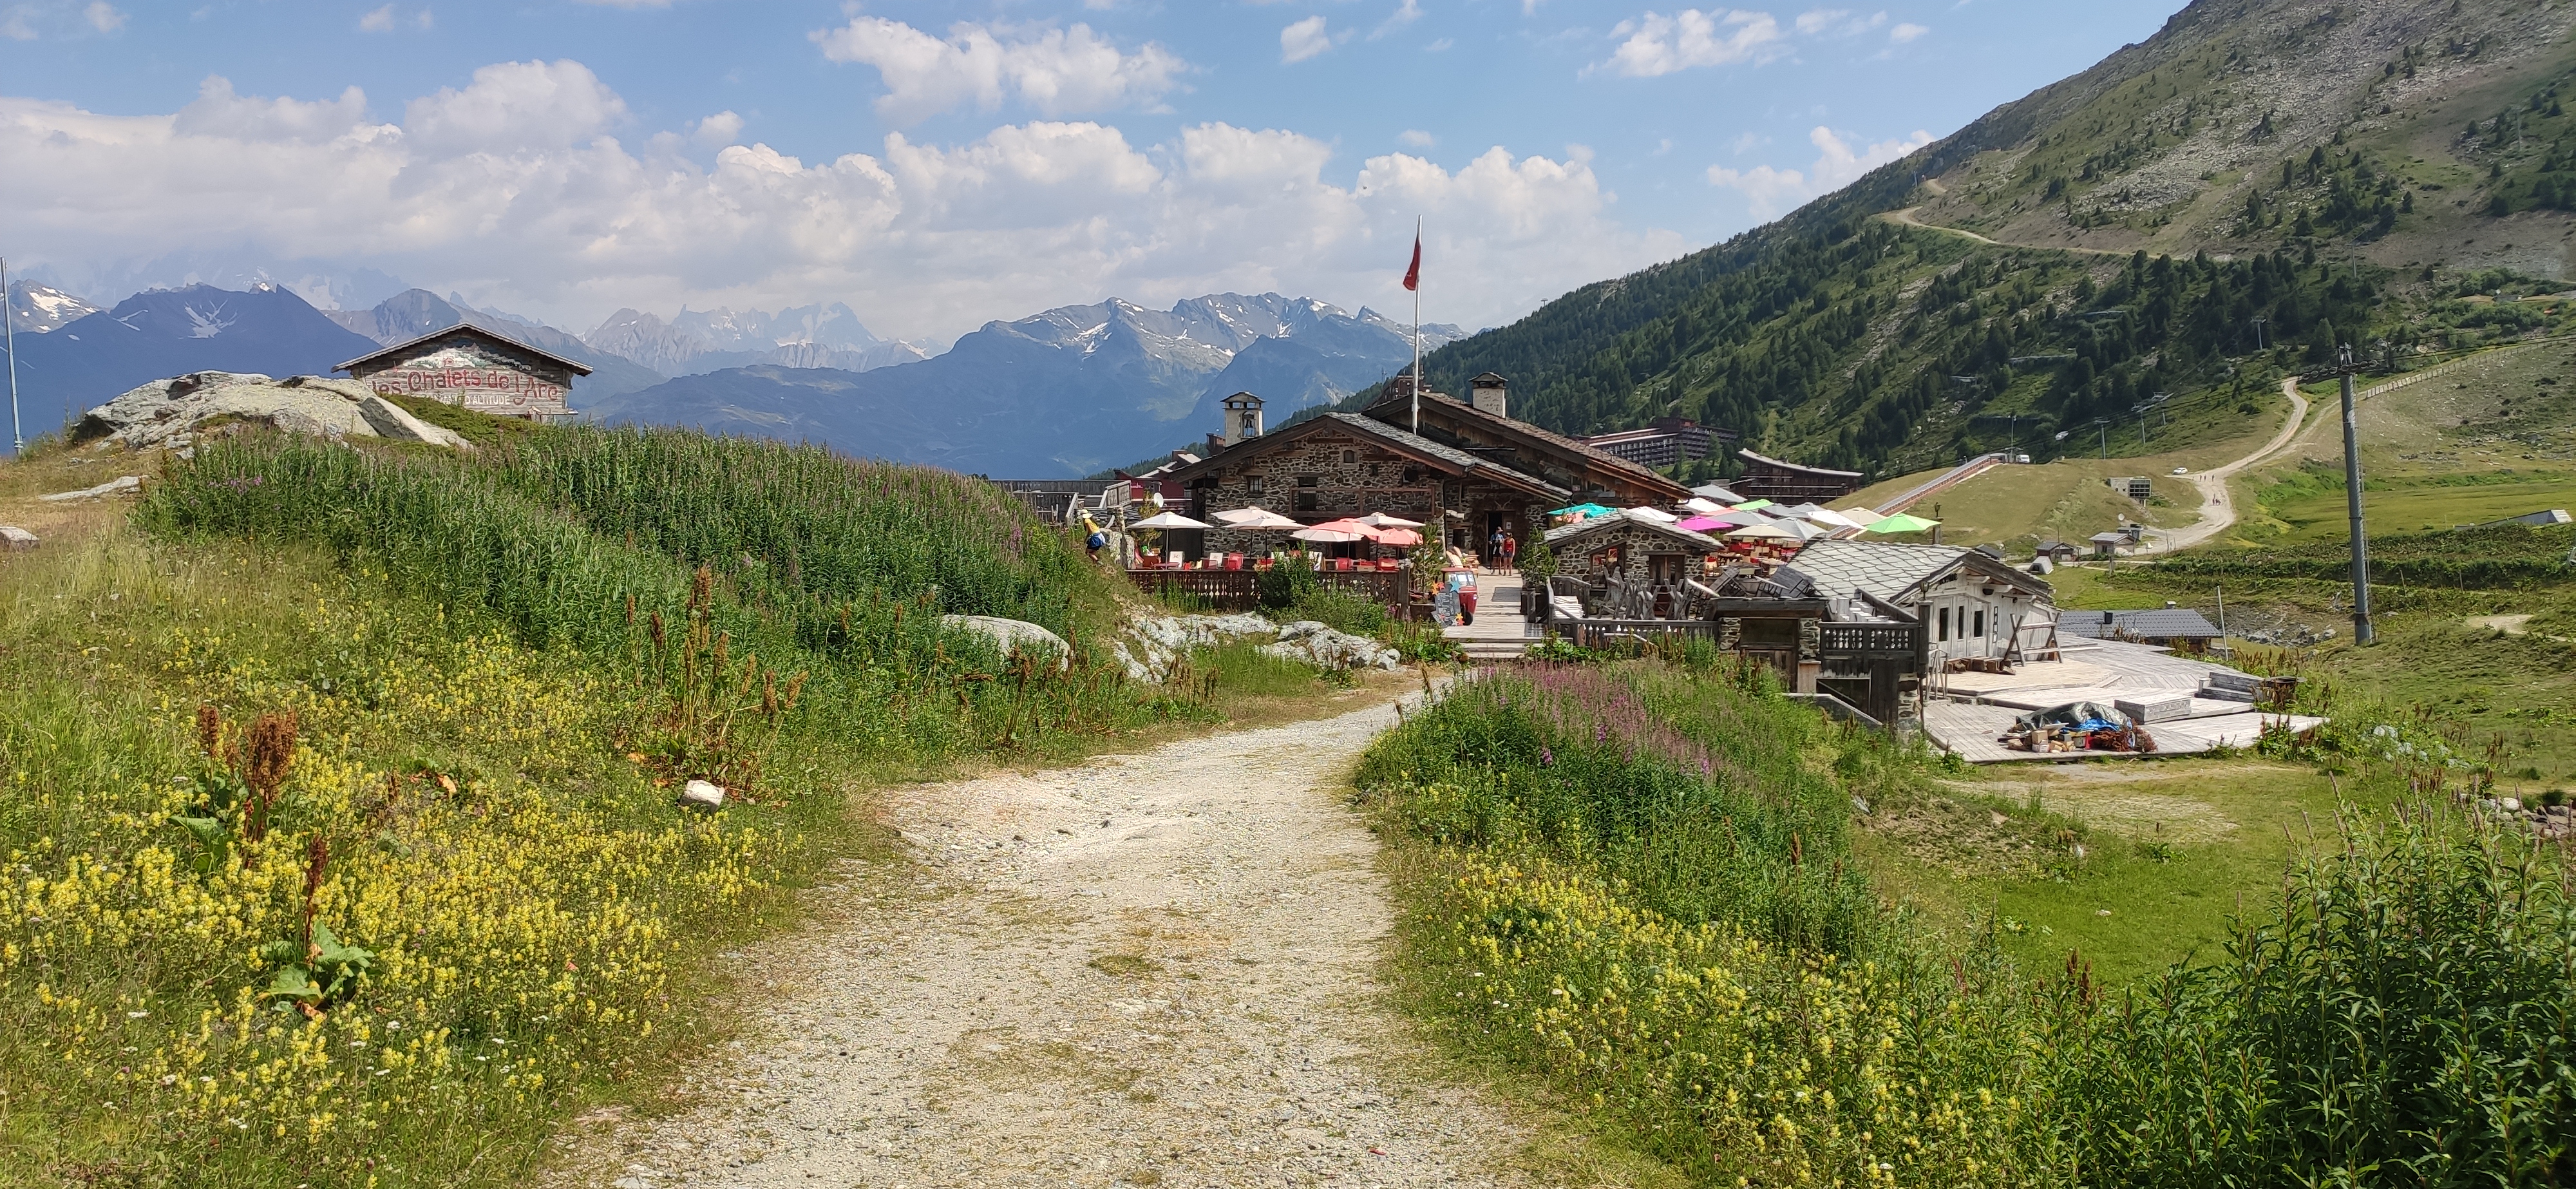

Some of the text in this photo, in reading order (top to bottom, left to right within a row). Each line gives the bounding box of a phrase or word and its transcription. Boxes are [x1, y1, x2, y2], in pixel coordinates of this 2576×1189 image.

[408, 368, 482, 392] Chalets
[487, 370, 509, 390] de
[464, 395, 510, 406] D'ALTITUDE
